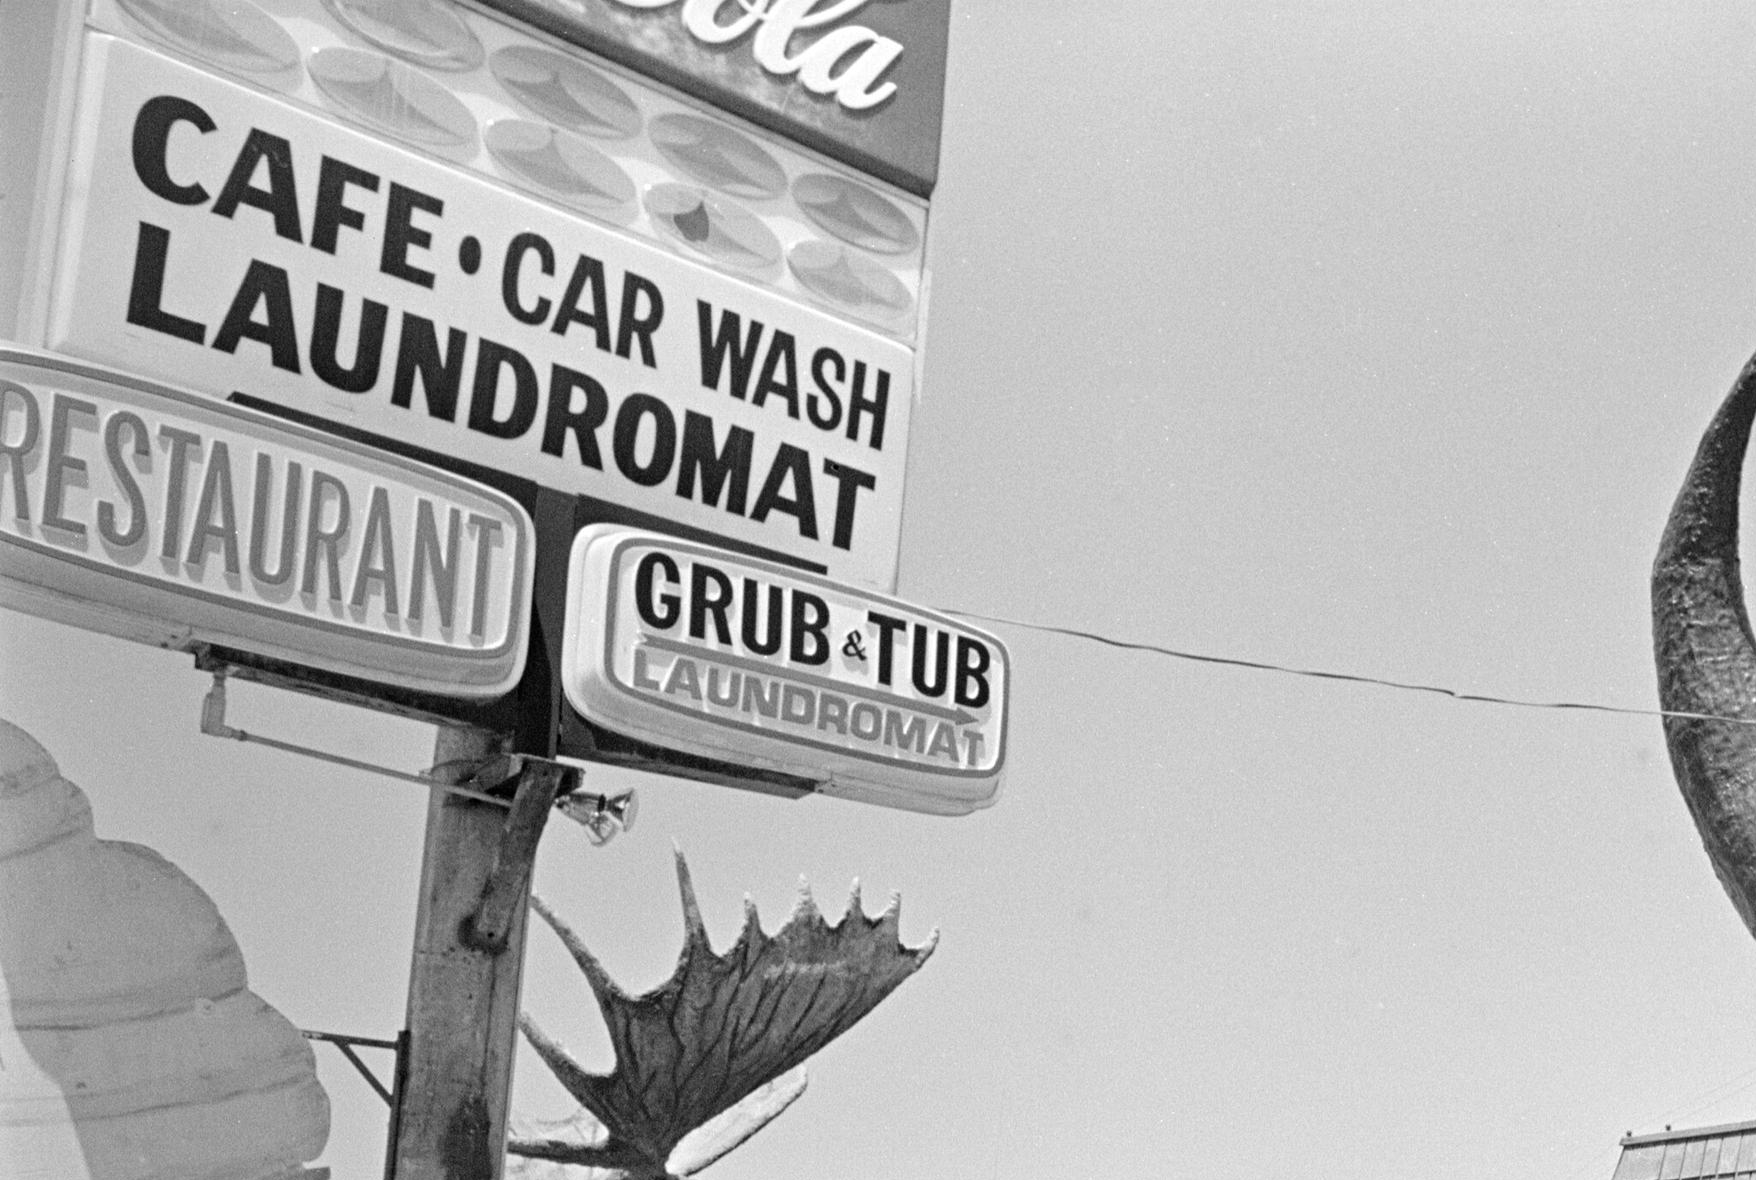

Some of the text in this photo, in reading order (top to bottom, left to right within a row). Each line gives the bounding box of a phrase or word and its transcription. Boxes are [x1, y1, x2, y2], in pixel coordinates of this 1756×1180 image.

[612, 0, 904, 110] ola
[132, 95, 892, 452] CAFE CAR WASH
[126, 220, 877, 551] LAUNDROMAT
[0, 379, 502, 638] RESTAURANT
[633, 648, 985, 768] LAUNDROMAT
[634, 551, 991, 709] GRUB & TUB
